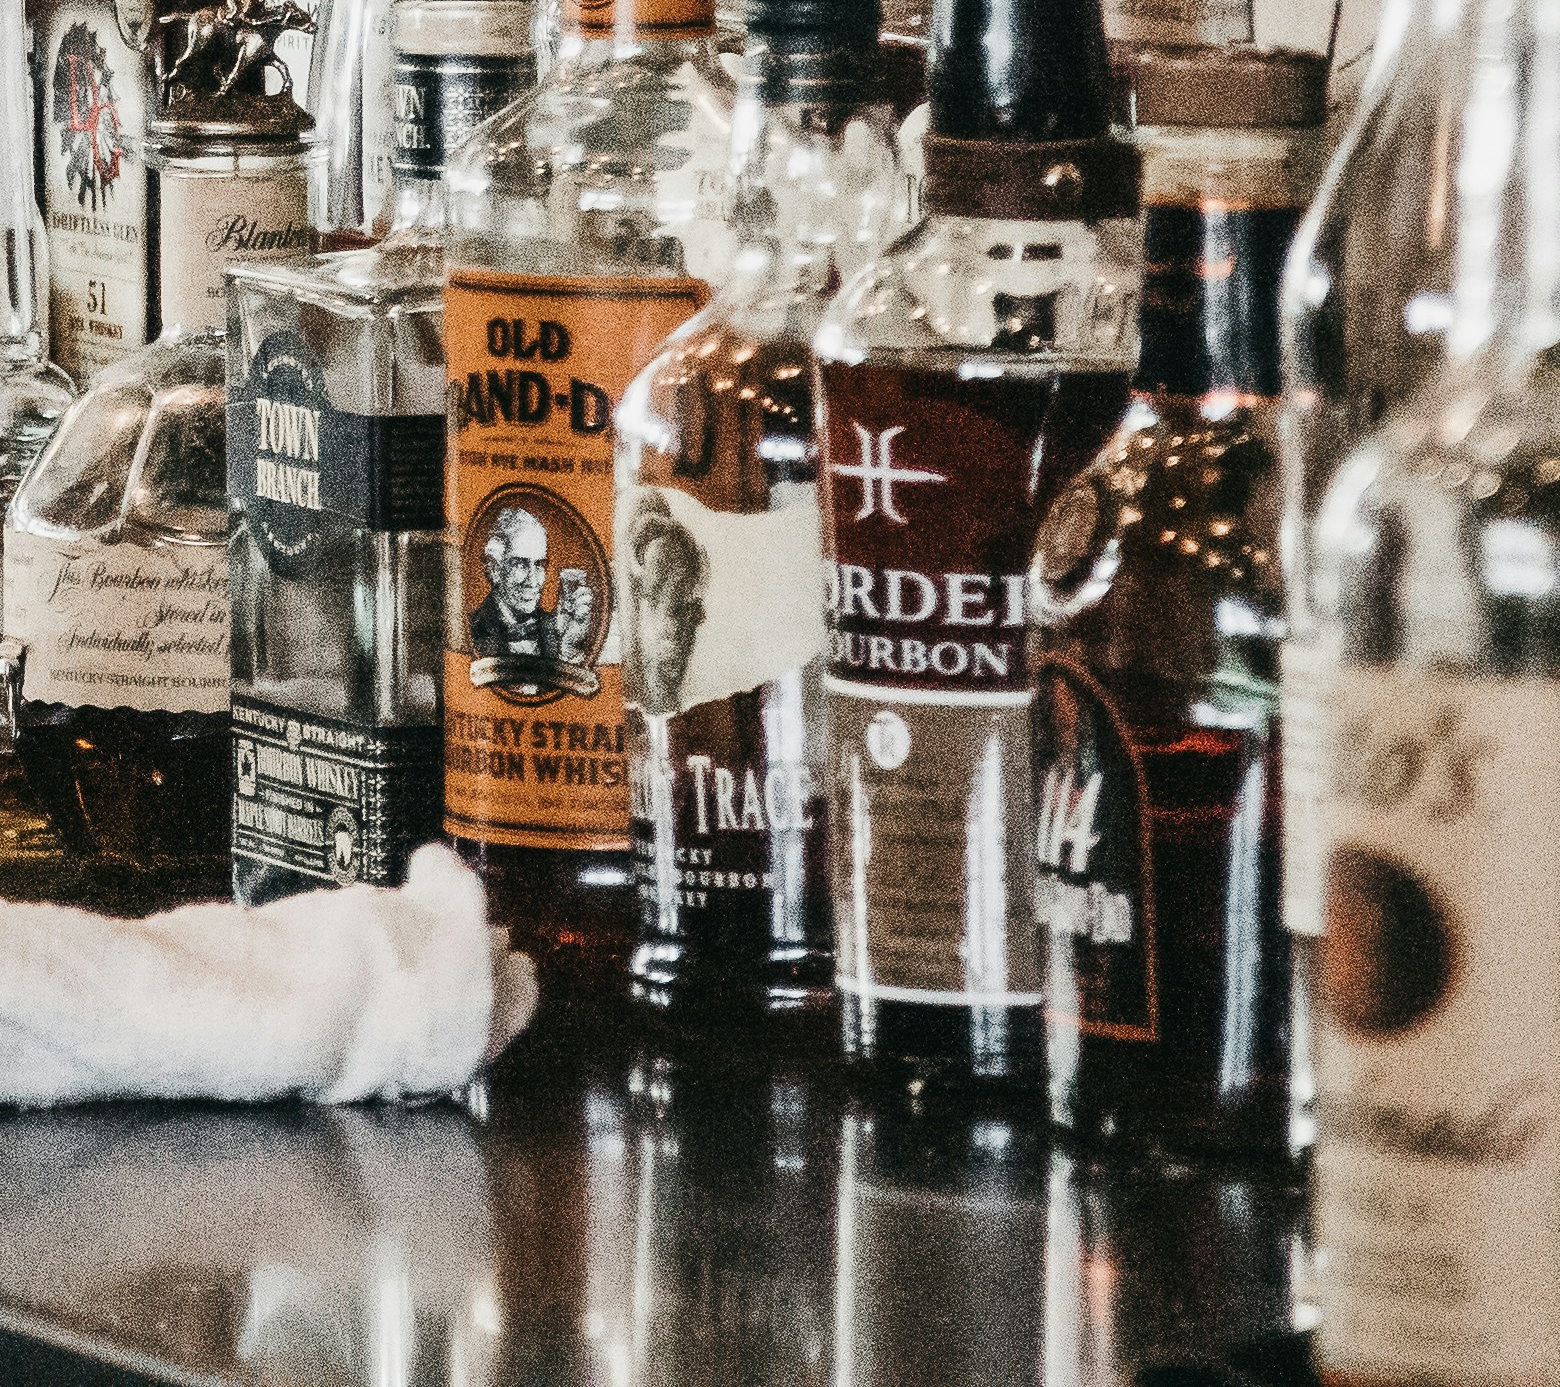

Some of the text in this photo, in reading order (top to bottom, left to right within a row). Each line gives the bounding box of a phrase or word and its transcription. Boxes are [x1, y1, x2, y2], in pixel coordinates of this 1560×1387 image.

[486, 317, 572, 364] OLD
[455, 367, 614, 435] AND-D
[256, 397, 321, 463] TOWN
[256, 458, 322, 510] BRANCH
[87, 560, 161, 591] Bourbon
[50, 669, 104, 685] KENTUCKY
[109, 671, 168, 688] STRAIGHT
[301, 723, 364, 750] STRAIGHT
[530, 720, 625, 753] STRAI
[533, 754, 626, 787] WHIS
